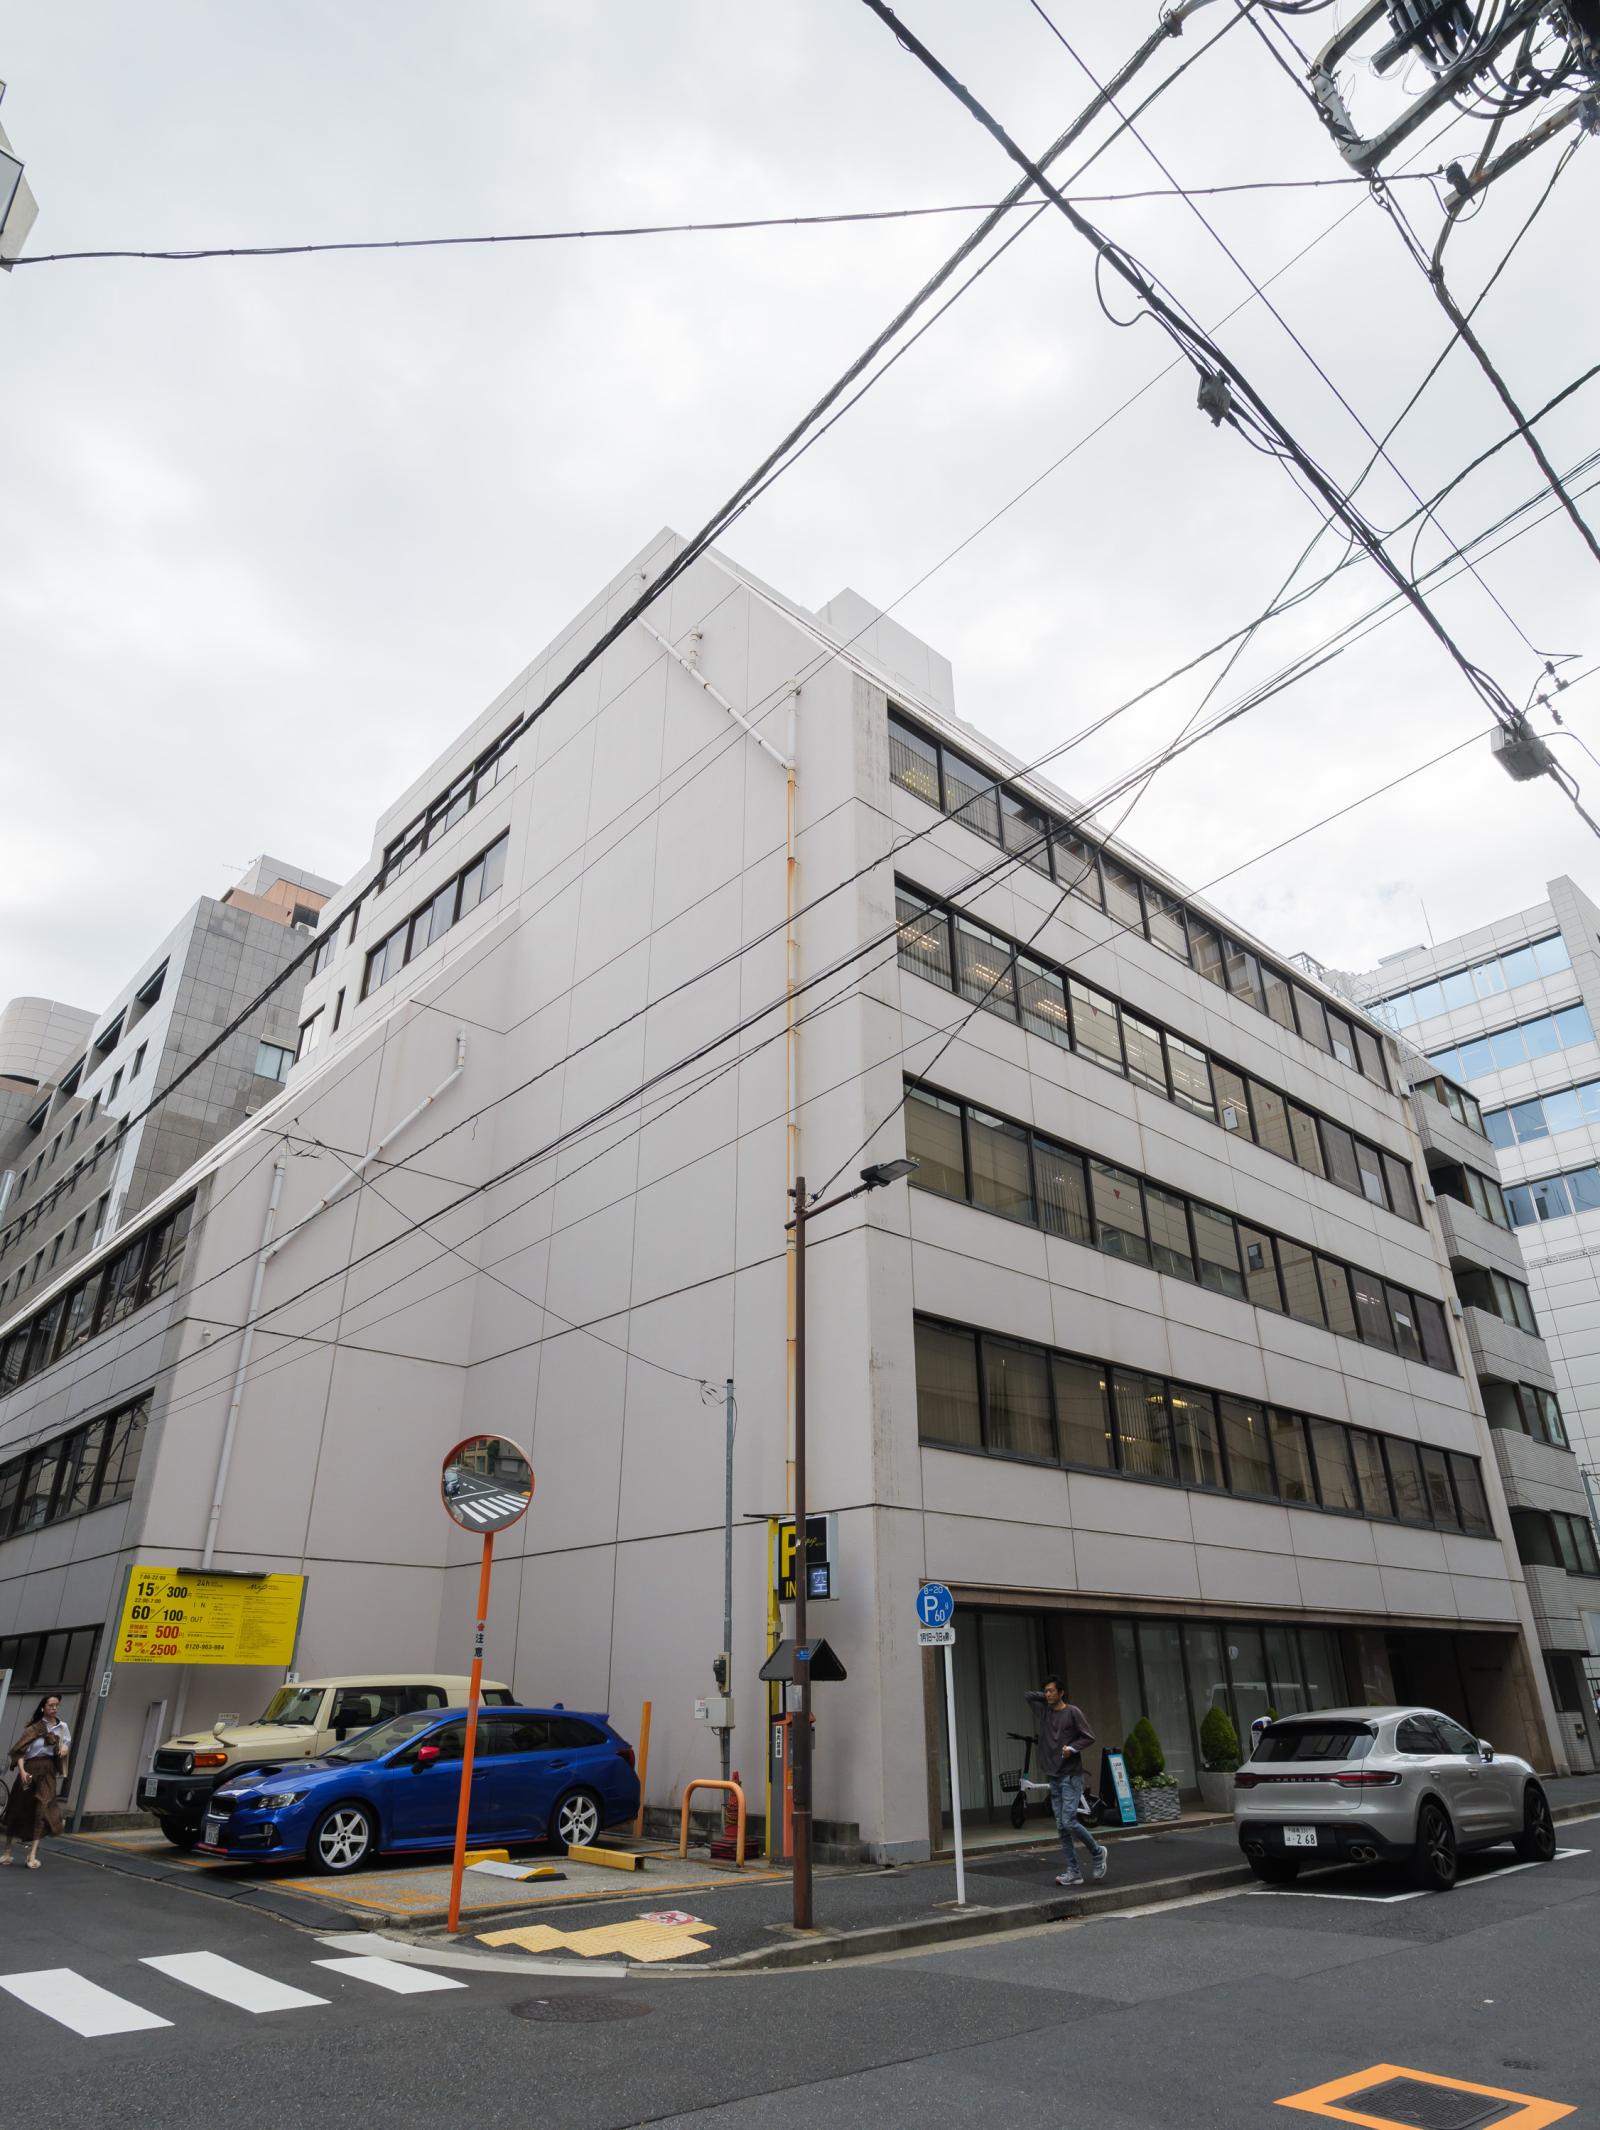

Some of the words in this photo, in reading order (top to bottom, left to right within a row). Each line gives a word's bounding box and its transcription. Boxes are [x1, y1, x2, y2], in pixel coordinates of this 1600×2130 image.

[923, 1586, 944, 1595] 8-20
[923, 1595, 939, 1623] P
[474, 1633, 485, 1658] 注意
